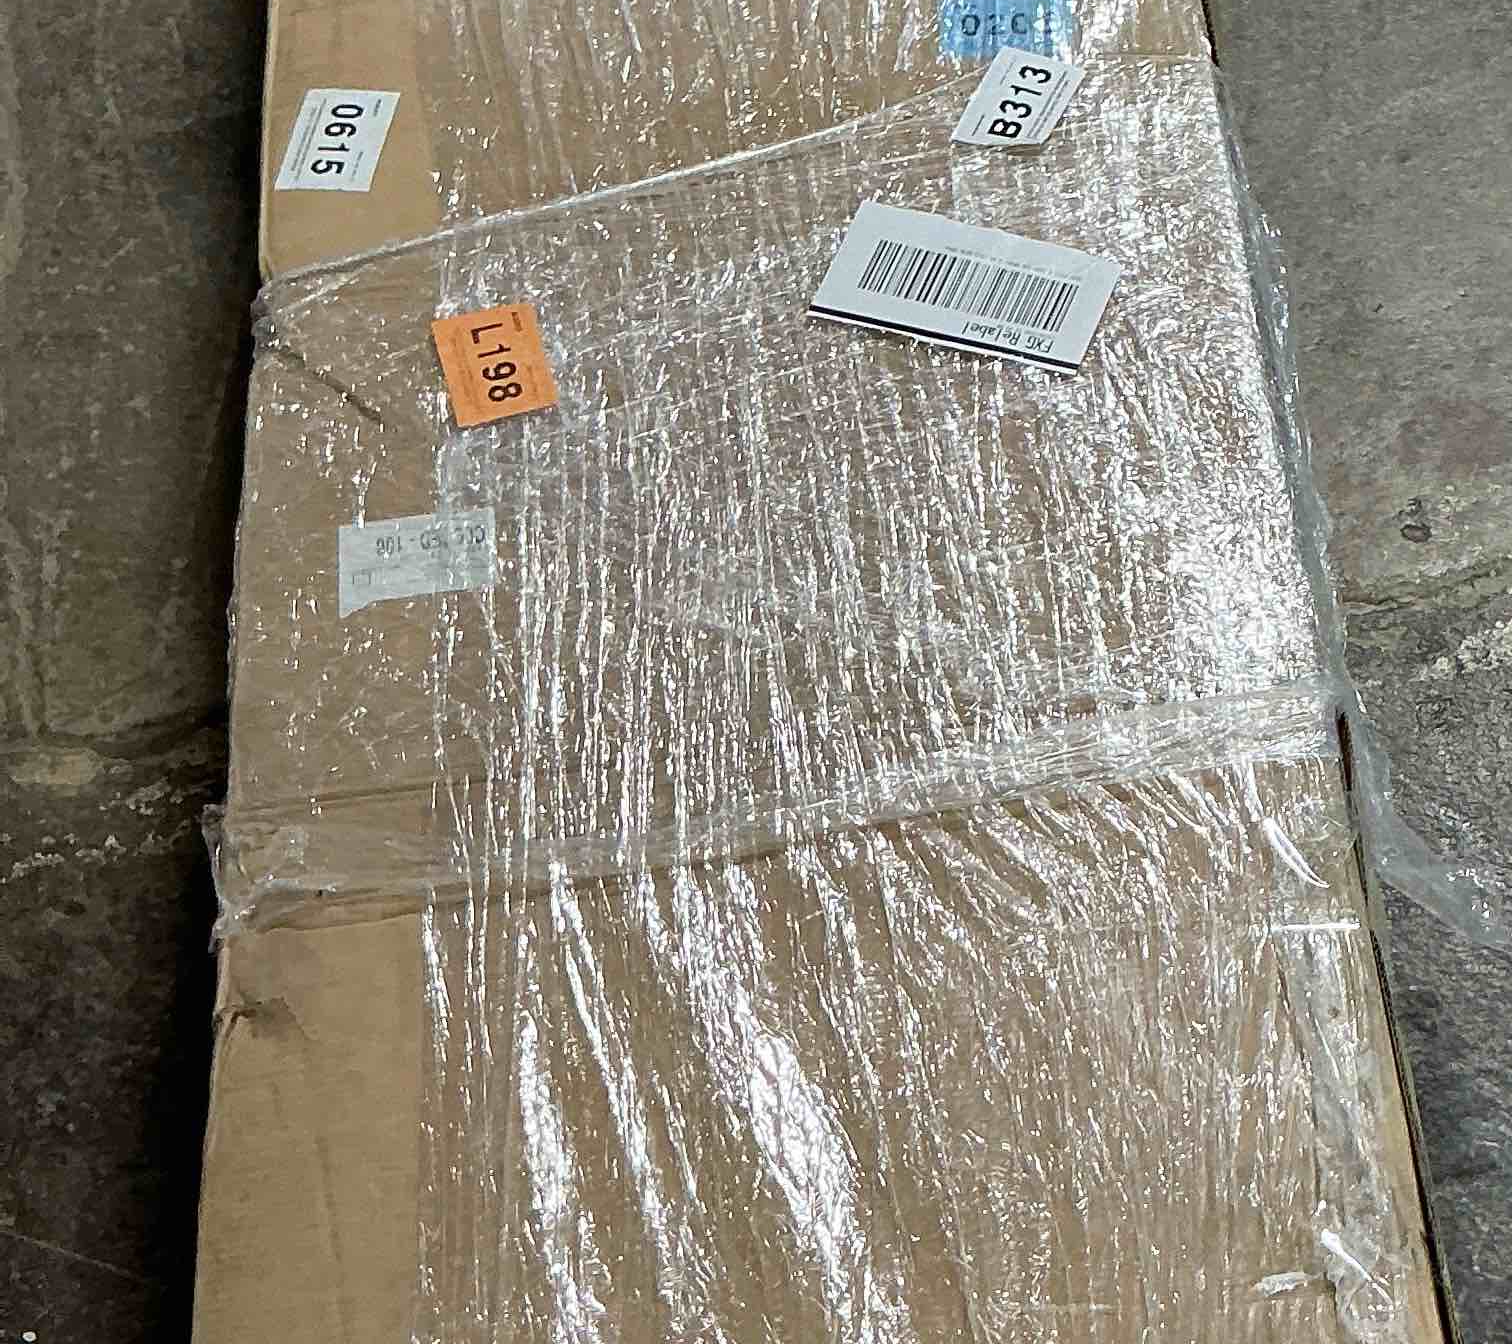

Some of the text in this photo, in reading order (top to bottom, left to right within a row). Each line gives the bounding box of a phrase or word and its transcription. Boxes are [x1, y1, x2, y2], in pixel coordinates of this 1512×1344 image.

[987, 65, 1052, 138] B313
[310, 104, 364, 174] 0615
[471, 323, 523, 402] L198
[961, 321, 1021, 346] Relabel
[1025, 336, 1054, 353] FXG
